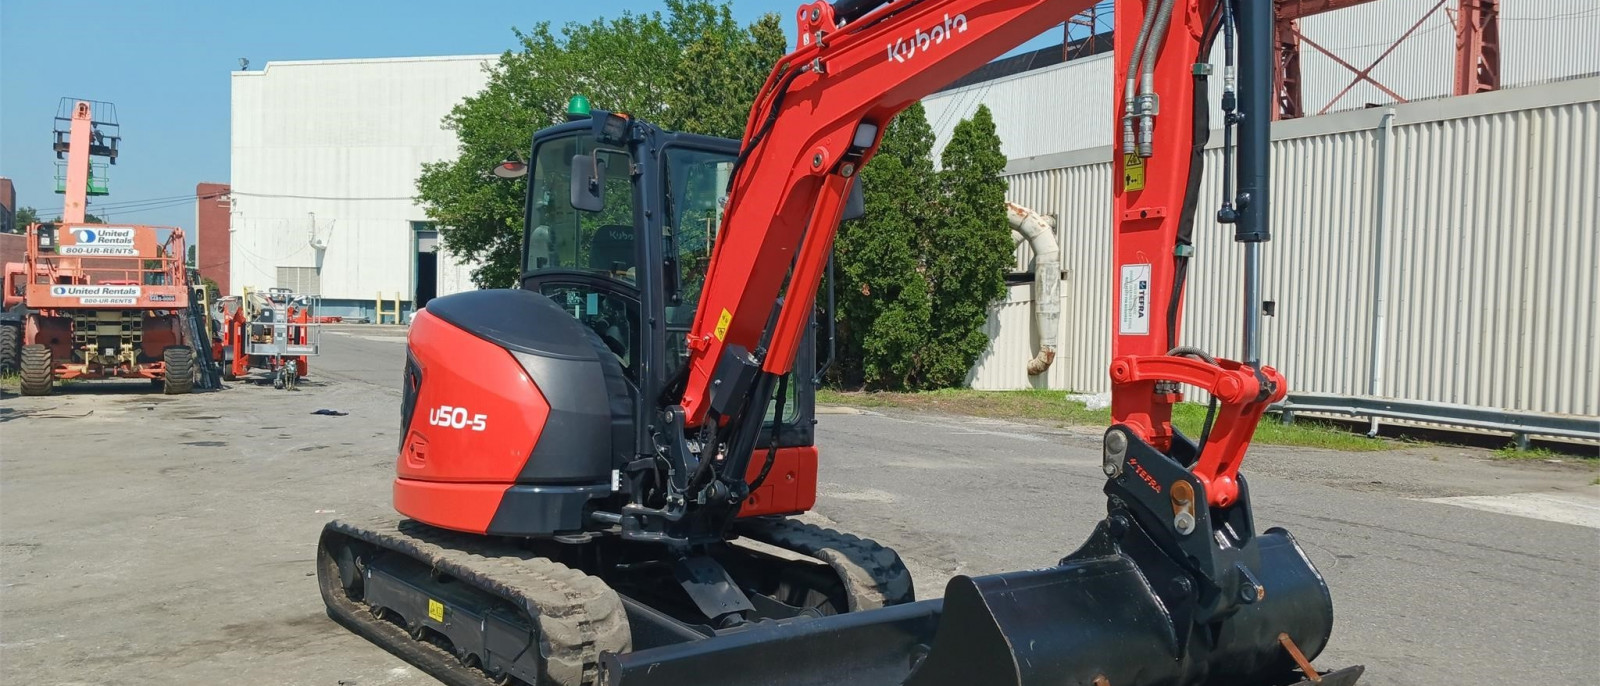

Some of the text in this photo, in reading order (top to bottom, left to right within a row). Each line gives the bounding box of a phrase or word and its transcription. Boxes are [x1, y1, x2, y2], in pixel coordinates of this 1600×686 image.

[887, 13, 968, 63] Kubota
[98, 229, 129, 237] United
[609, 230, 634, 241] Kubo
[98, 236, 132, 244] Rentals
[66, 246, 134, 254] 800-UR-RENTS
[68, 287, 137, 295] United Rentals
[429, 405, 488, 431] U50-5
[1136, 464, 1162, 493] TEFRA
